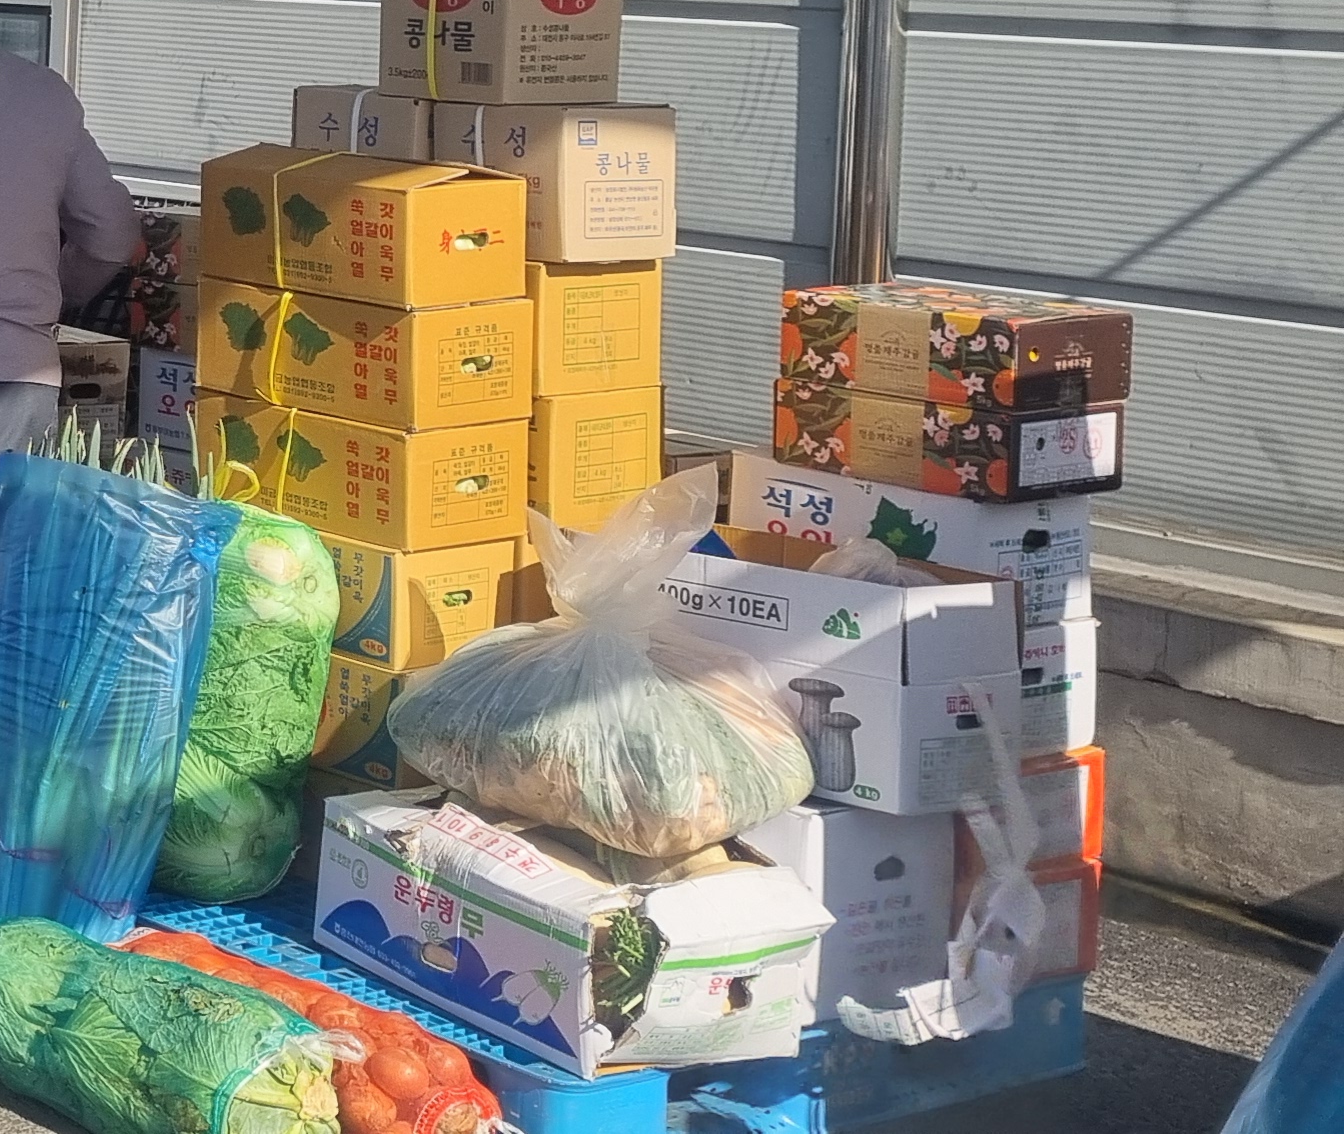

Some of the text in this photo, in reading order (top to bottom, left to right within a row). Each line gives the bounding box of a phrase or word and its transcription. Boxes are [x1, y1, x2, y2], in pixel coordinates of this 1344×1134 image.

[404, 18, 476, 52] 콩나물
[388, 66, 428, 80] 3.5kg±200
[318, 112, 379, 147] 수성
[462, 123, 527, 158] 수성
[595, 151, 651, 176] 콩나물
[350, 221, 394, 242] 얼갈이
[354, 341, 399, 364] 얼갈이
[346, 459, 390, 484] 얼갈이
[762, 486, 834, 526] 석성
[727, 595, 782, 623] 10EA
[394, 875, 485, 939] 운두령 무
